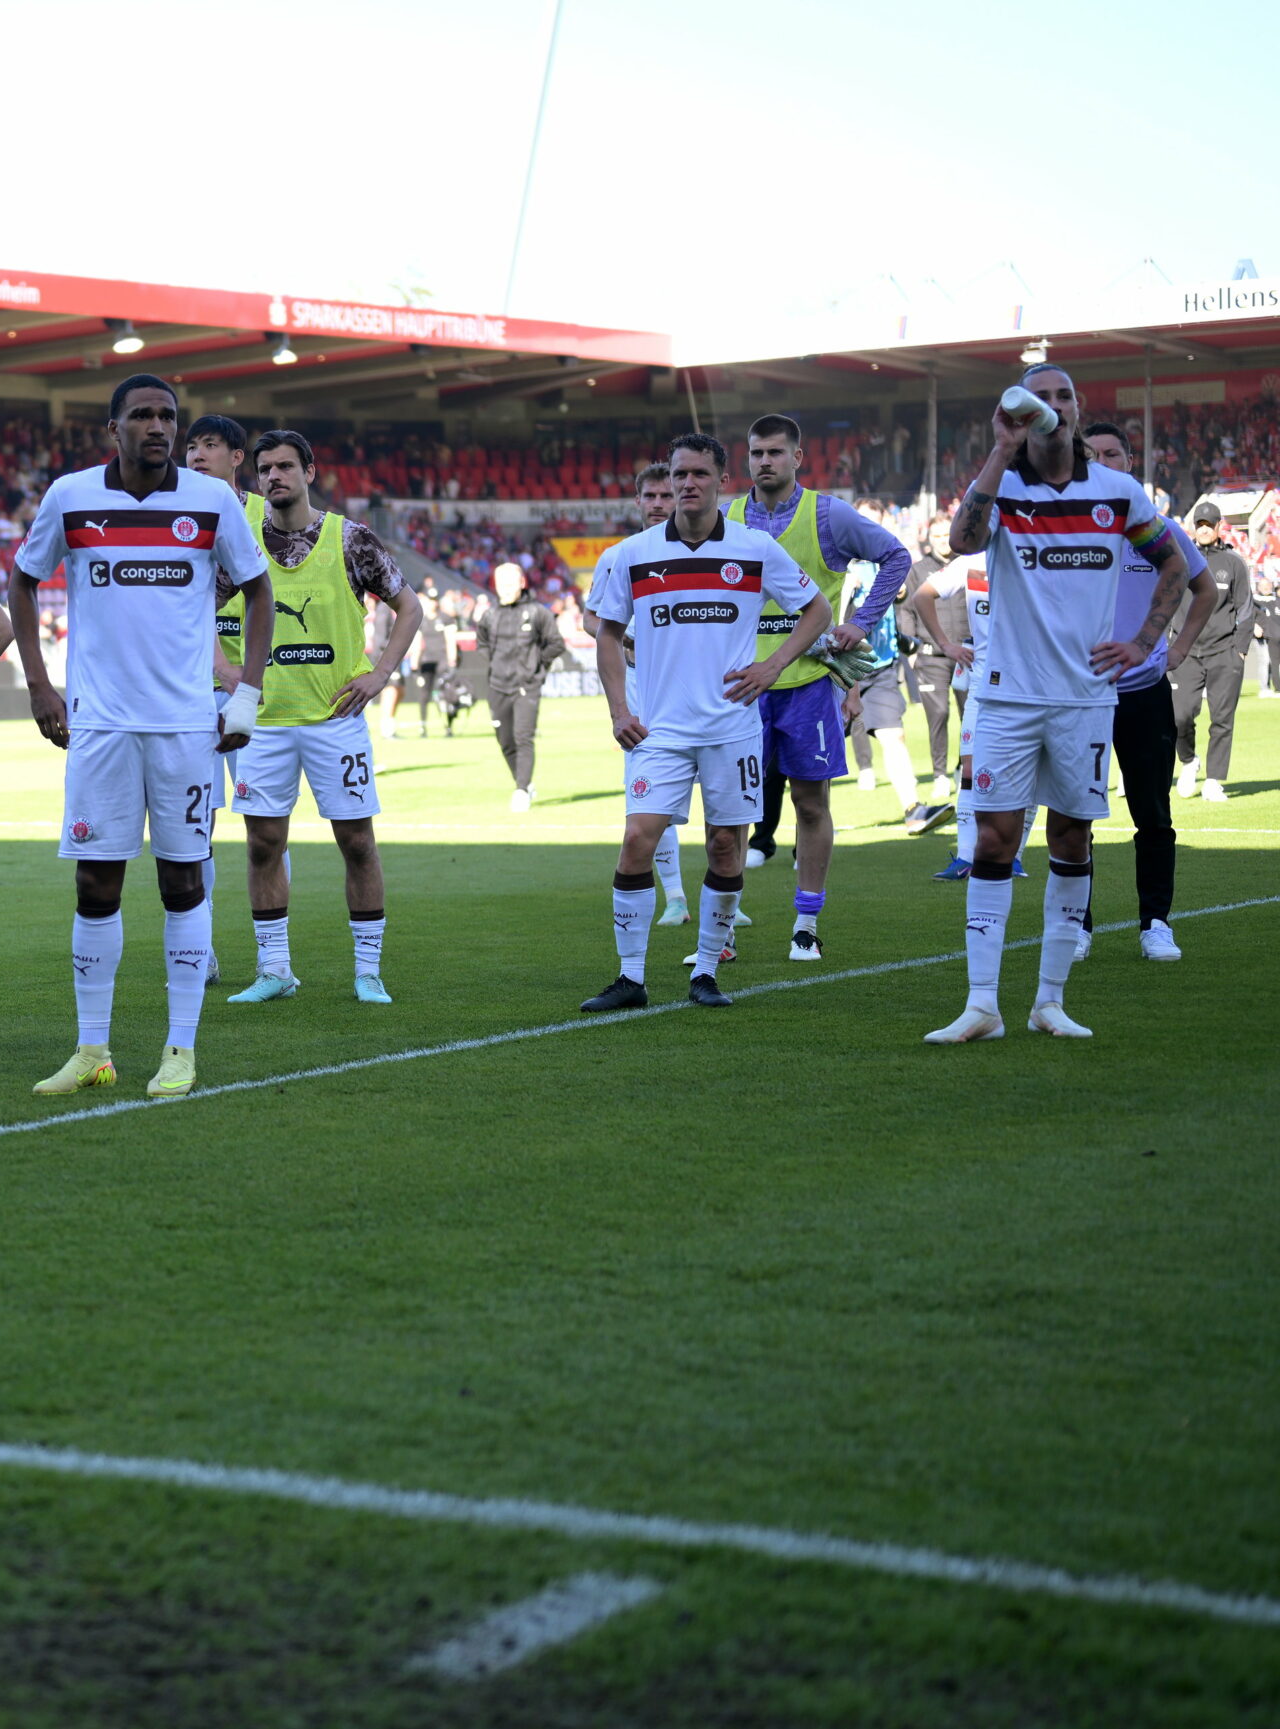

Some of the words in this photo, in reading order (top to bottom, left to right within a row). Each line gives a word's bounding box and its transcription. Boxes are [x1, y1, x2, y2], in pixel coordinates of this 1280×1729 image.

[1184, 287, 1279, 313] Hellens
[292, 301, 392, 334] SPARKASSEN
[394, 312, 506, 345] HAUPTTRIBÜNE
[1047, 551, 1107, 566] congstar
[121, 565, 187, 584] congstar
[678, 606, 733, 620] congstar
[279, 649, 331, 661] congstar
[817, 720, 825, 752] 1
[341, 752, 369, 788] 25
[737, 755, 761, 791] 19
[1090, 743, 1106, 782] 7
